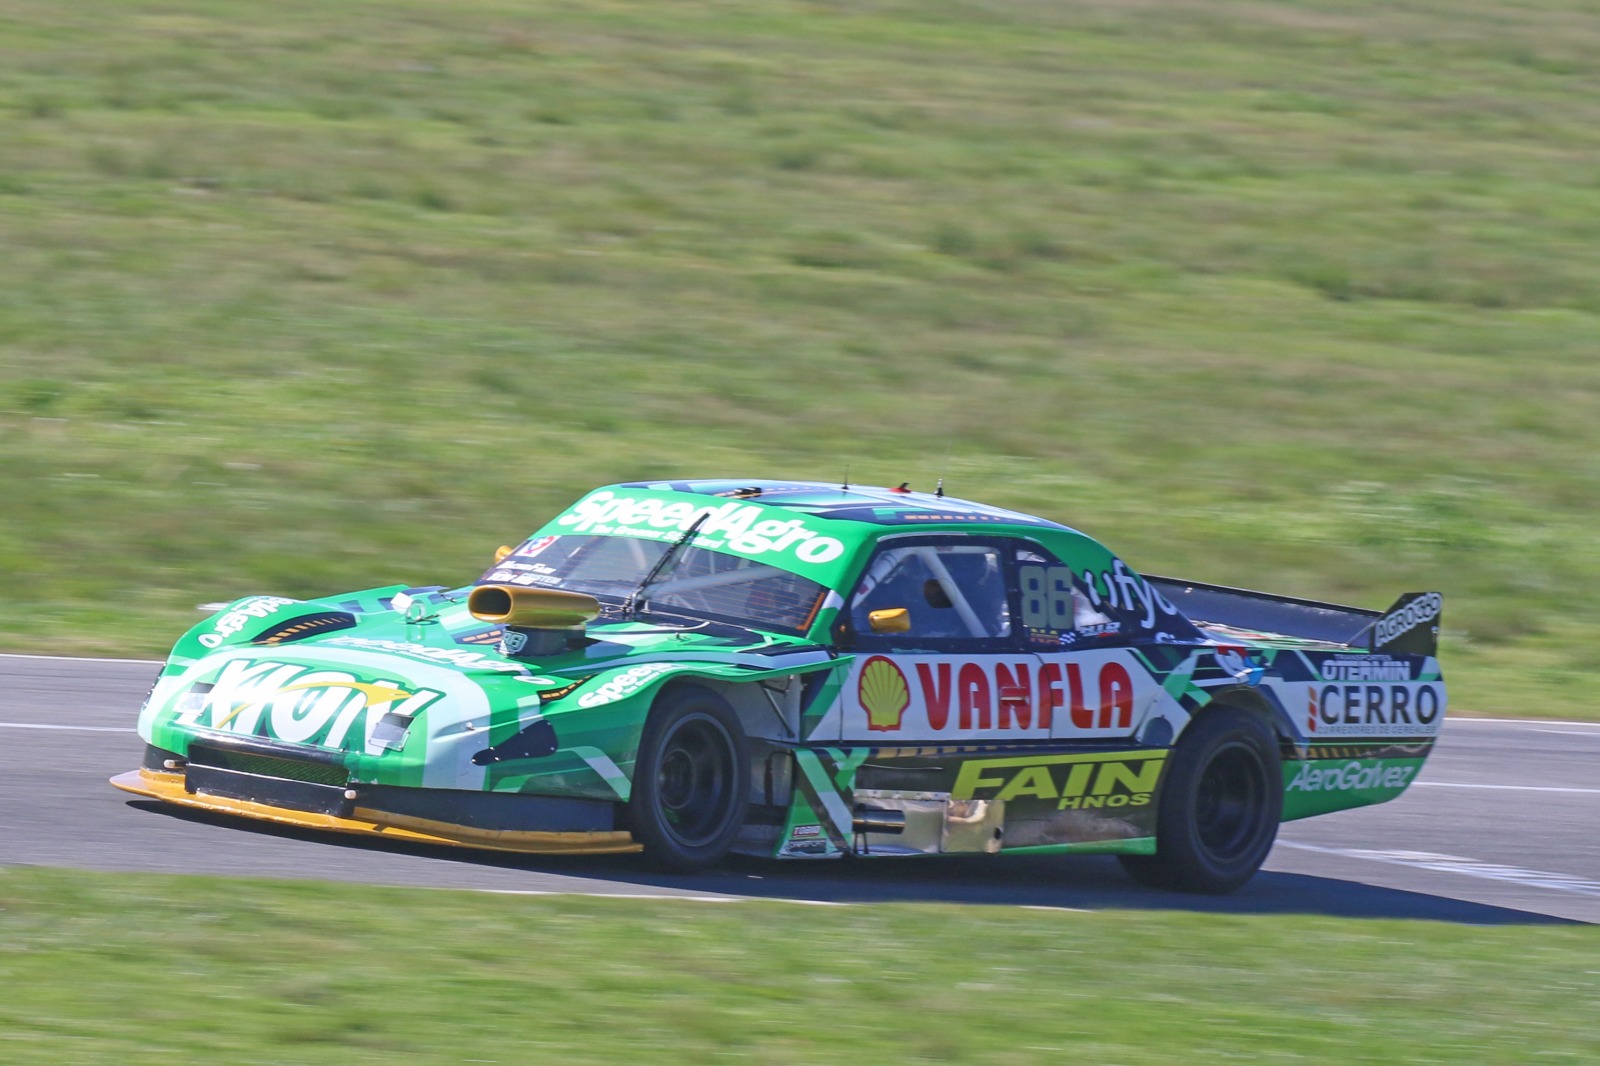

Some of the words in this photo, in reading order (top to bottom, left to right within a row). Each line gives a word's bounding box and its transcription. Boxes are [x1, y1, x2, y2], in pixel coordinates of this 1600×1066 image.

[558, 490, 844, 563] SpeedAgro
[1020, 566, 1074, 629] 86
[915, 662, 1133, 732] VANFLA
[1320, 685, 1438, 724] CERRO
[952, 749, 1168, 802] FAIN
[1057, 793, 1151, 810] HNOS
